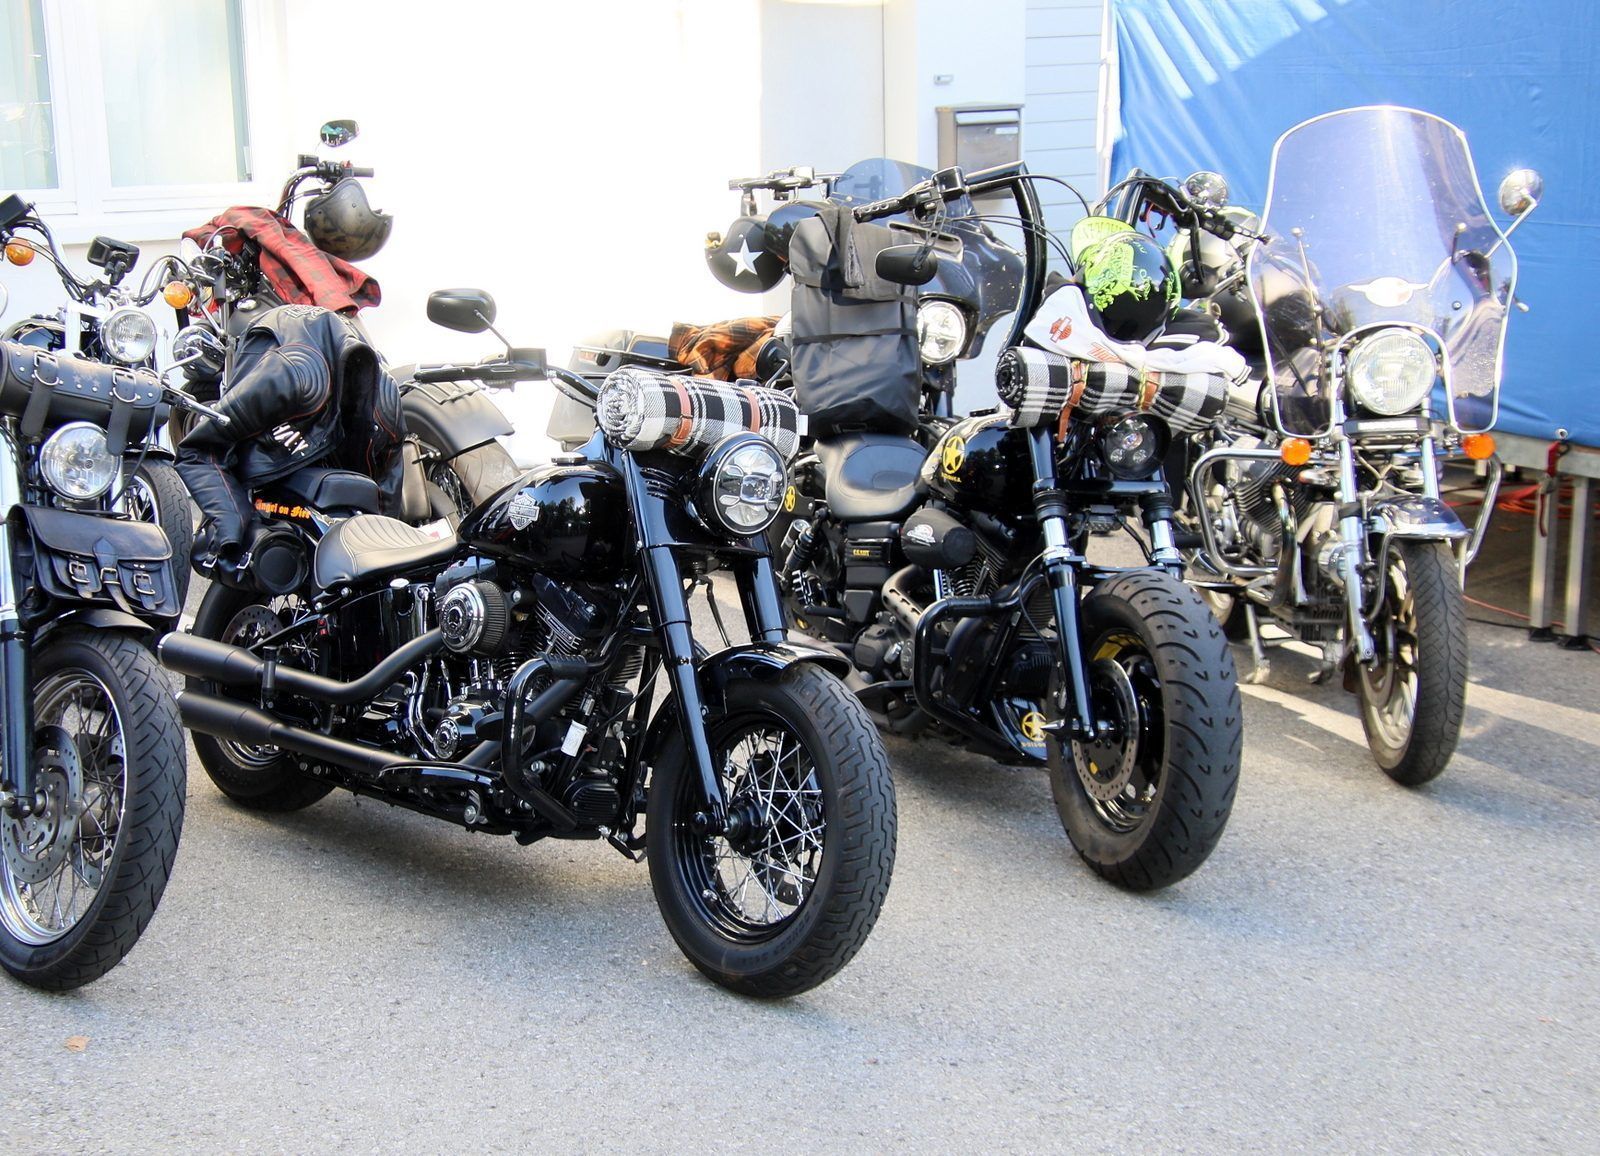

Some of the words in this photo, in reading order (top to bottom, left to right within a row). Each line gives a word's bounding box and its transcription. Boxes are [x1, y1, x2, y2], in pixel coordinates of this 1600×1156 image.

[254, 498, 278, 514] Angel
[279, 505, 289, 515] on
[290, 505, 311, 519] Fire
